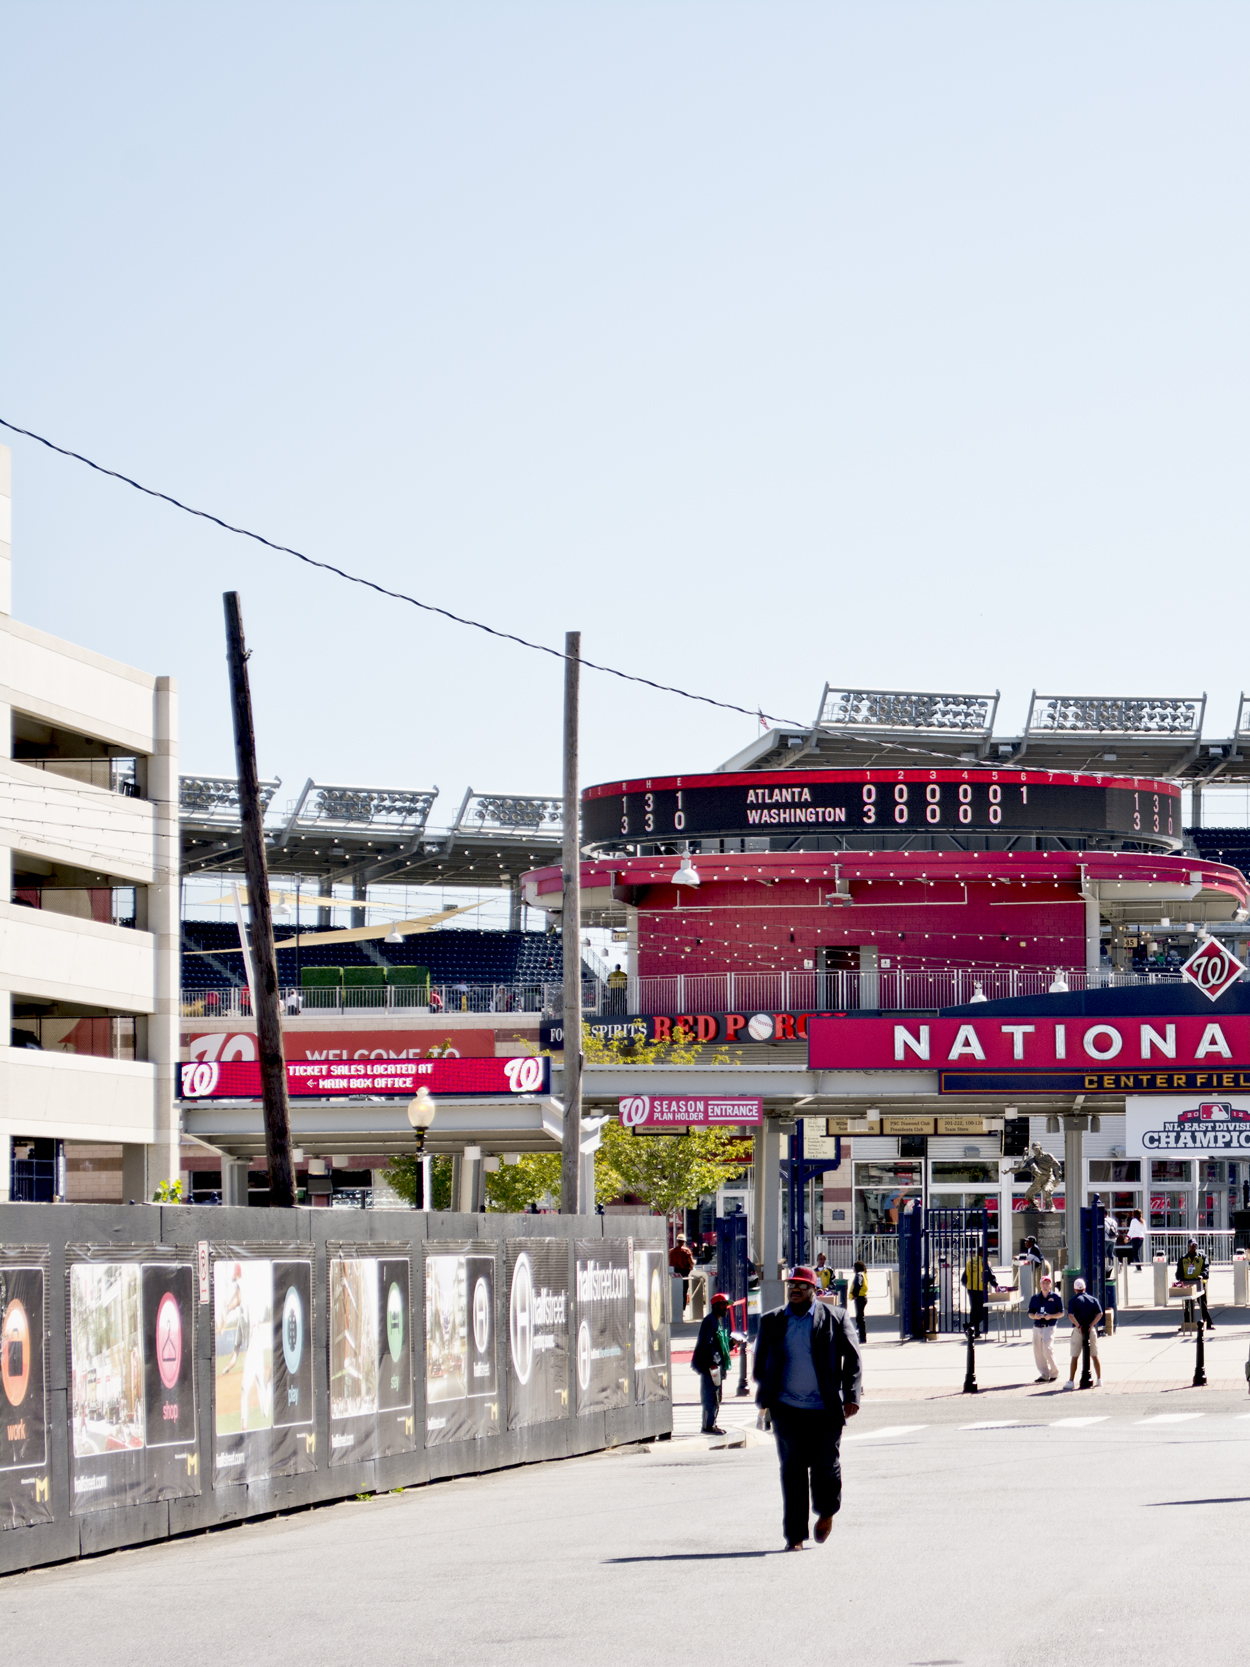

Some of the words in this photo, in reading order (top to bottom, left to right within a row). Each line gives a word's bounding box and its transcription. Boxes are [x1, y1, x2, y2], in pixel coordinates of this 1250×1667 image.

[866, 771, 871, 779] 1
[898, 771, 904, 779] 2
[930, 771, 937, 779] 3
[962, 771, 968, 780] 4
[992, 771, 998, 780] 5
[1020, 772, 1027, 781] 6
[622, 796, 627, 814] 1
[644, 793, 654, 812] 3
[676, 790, 682, 810] 1
[747, 787, 811, 804] ATLANTA
[862, 784, 876, 803] 0
[894, 784, 908, 803] 0
[926, 784, 940, 803] 0
[958, 784, 972, 803] 0
[989, 785, 1002, 803] 0
[1020, 785, 1028, 804] 1
[1133, 792, 1139, 811] 1
[1153, 794, 1159, 813] 3
[621, 815, 629, 835] 3
[644, 813, 654, 832] 3
[674, 811, 685, 830] 0
[747, 807, 846, 824] WASHINGTON
[862, 805, 876, 824] 3
[894, 805, 908, 824] 0
[926, 805, 940, 824] 0
[958, 805, 972, 824] 0
[989, 805, 1002, 824] 0
[1133, 812, 1141, 830] 3
[1153, 814, 1160, 833] 3
[1168, 817, 1174, 835] 0
[653, 1014, 718, 1042] RED
[287, 1065, 327, 1076] TICKET
[330, 1064, 365, 1076] SALES
[367, 1064, 416, 1075] LOCATED
[418, 1063, 433, 1074] AT
[318, 1079, 348, 1089] MAIN
[350, 1078, 372, 1088] BOX
[374, 1078, 413, 1088] OFFICE
[1084, 1074, 1187, 1090] CENTER
[653, 1101, 704, 1112] SEASON
[708, 1105, 758, 1116] ENTRANCE
[653, 1112, 673, 1120] PLAN
[675, 1112, 704, 1120] HOLDER
[577, 1260, 628, 1302] halfstreet.com
[532, 1287, 566, 1325] halfstreet
[288, 1384, 298, 1407] play
[162, 1401, 179, 1424] shop
[6, 1418, 26, 1442] work
[74, 1474, 107, 1493] halfstreet.com
